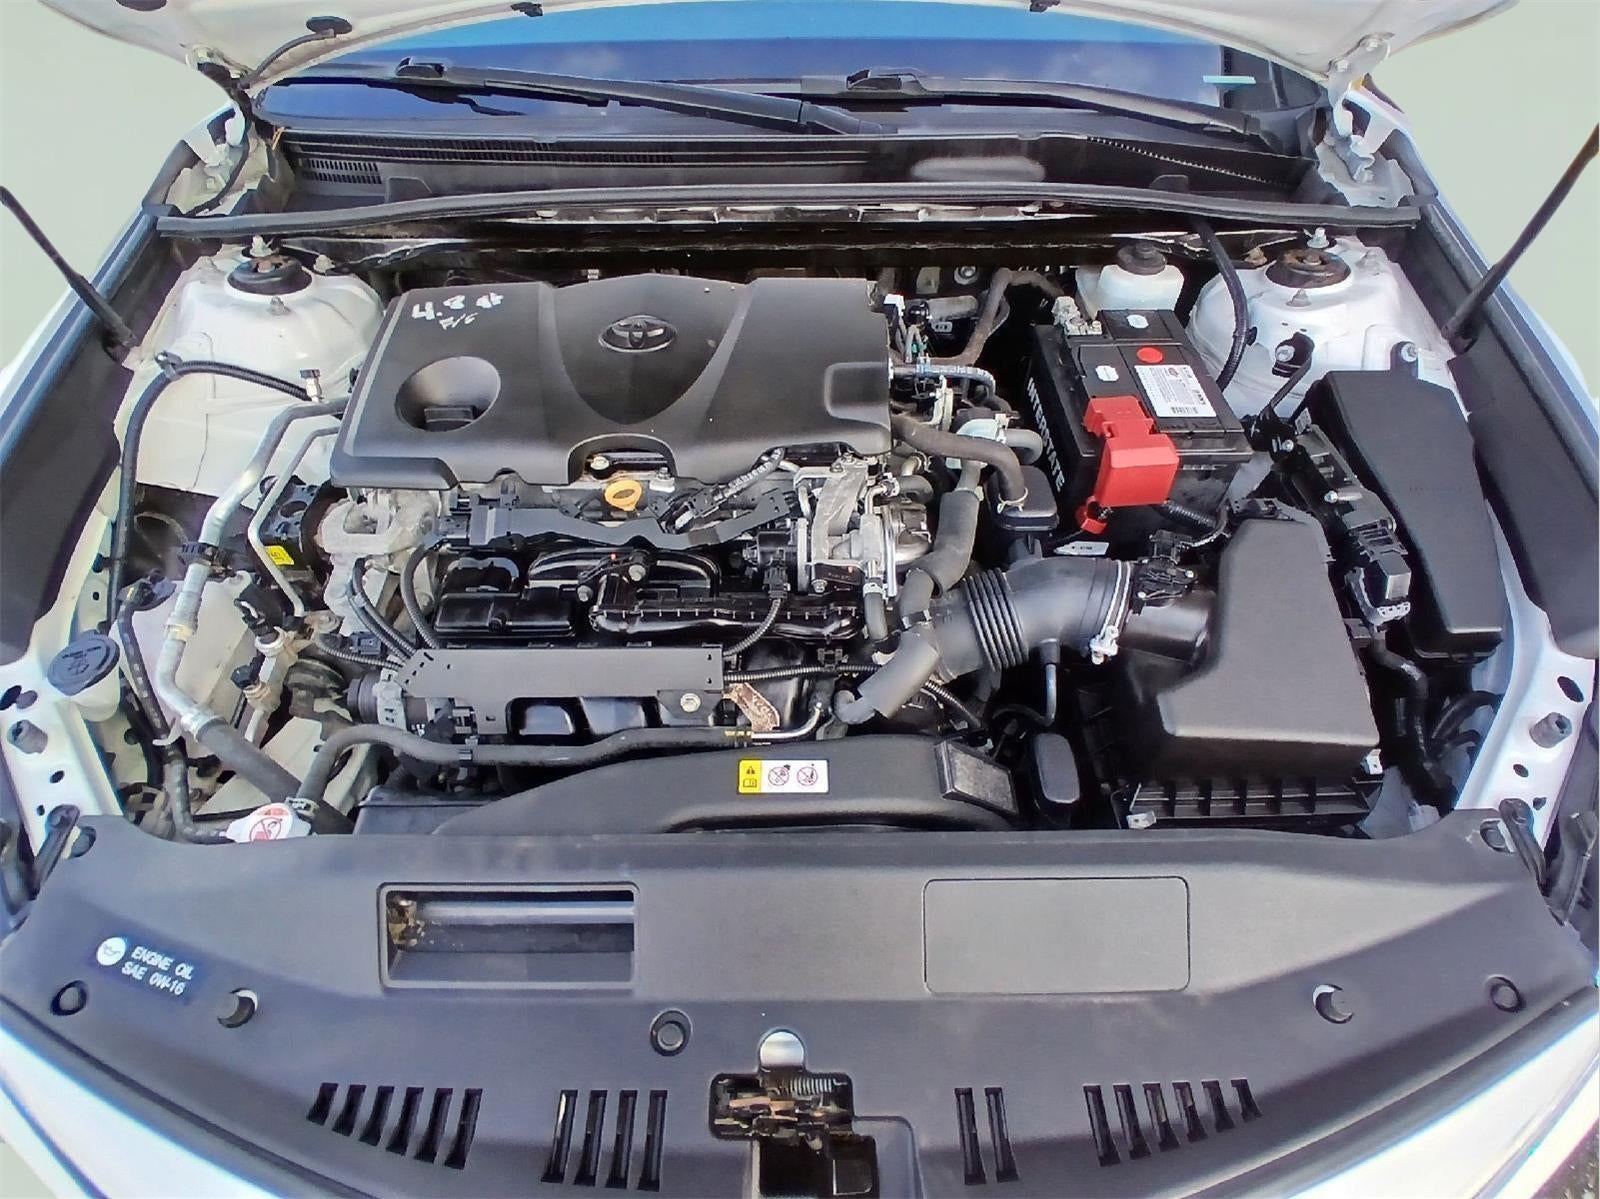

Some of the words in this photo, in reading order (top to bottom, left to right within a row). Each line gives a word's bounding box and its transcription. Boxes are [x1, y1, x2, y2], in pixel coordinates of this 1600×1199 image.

[1026, 376, 1066, 493] INTERSTATE
[121, 960, 148, 981] SAE
[130, 945, 175, 972] ENGINE
[174, 962, 194, 981] OIL
